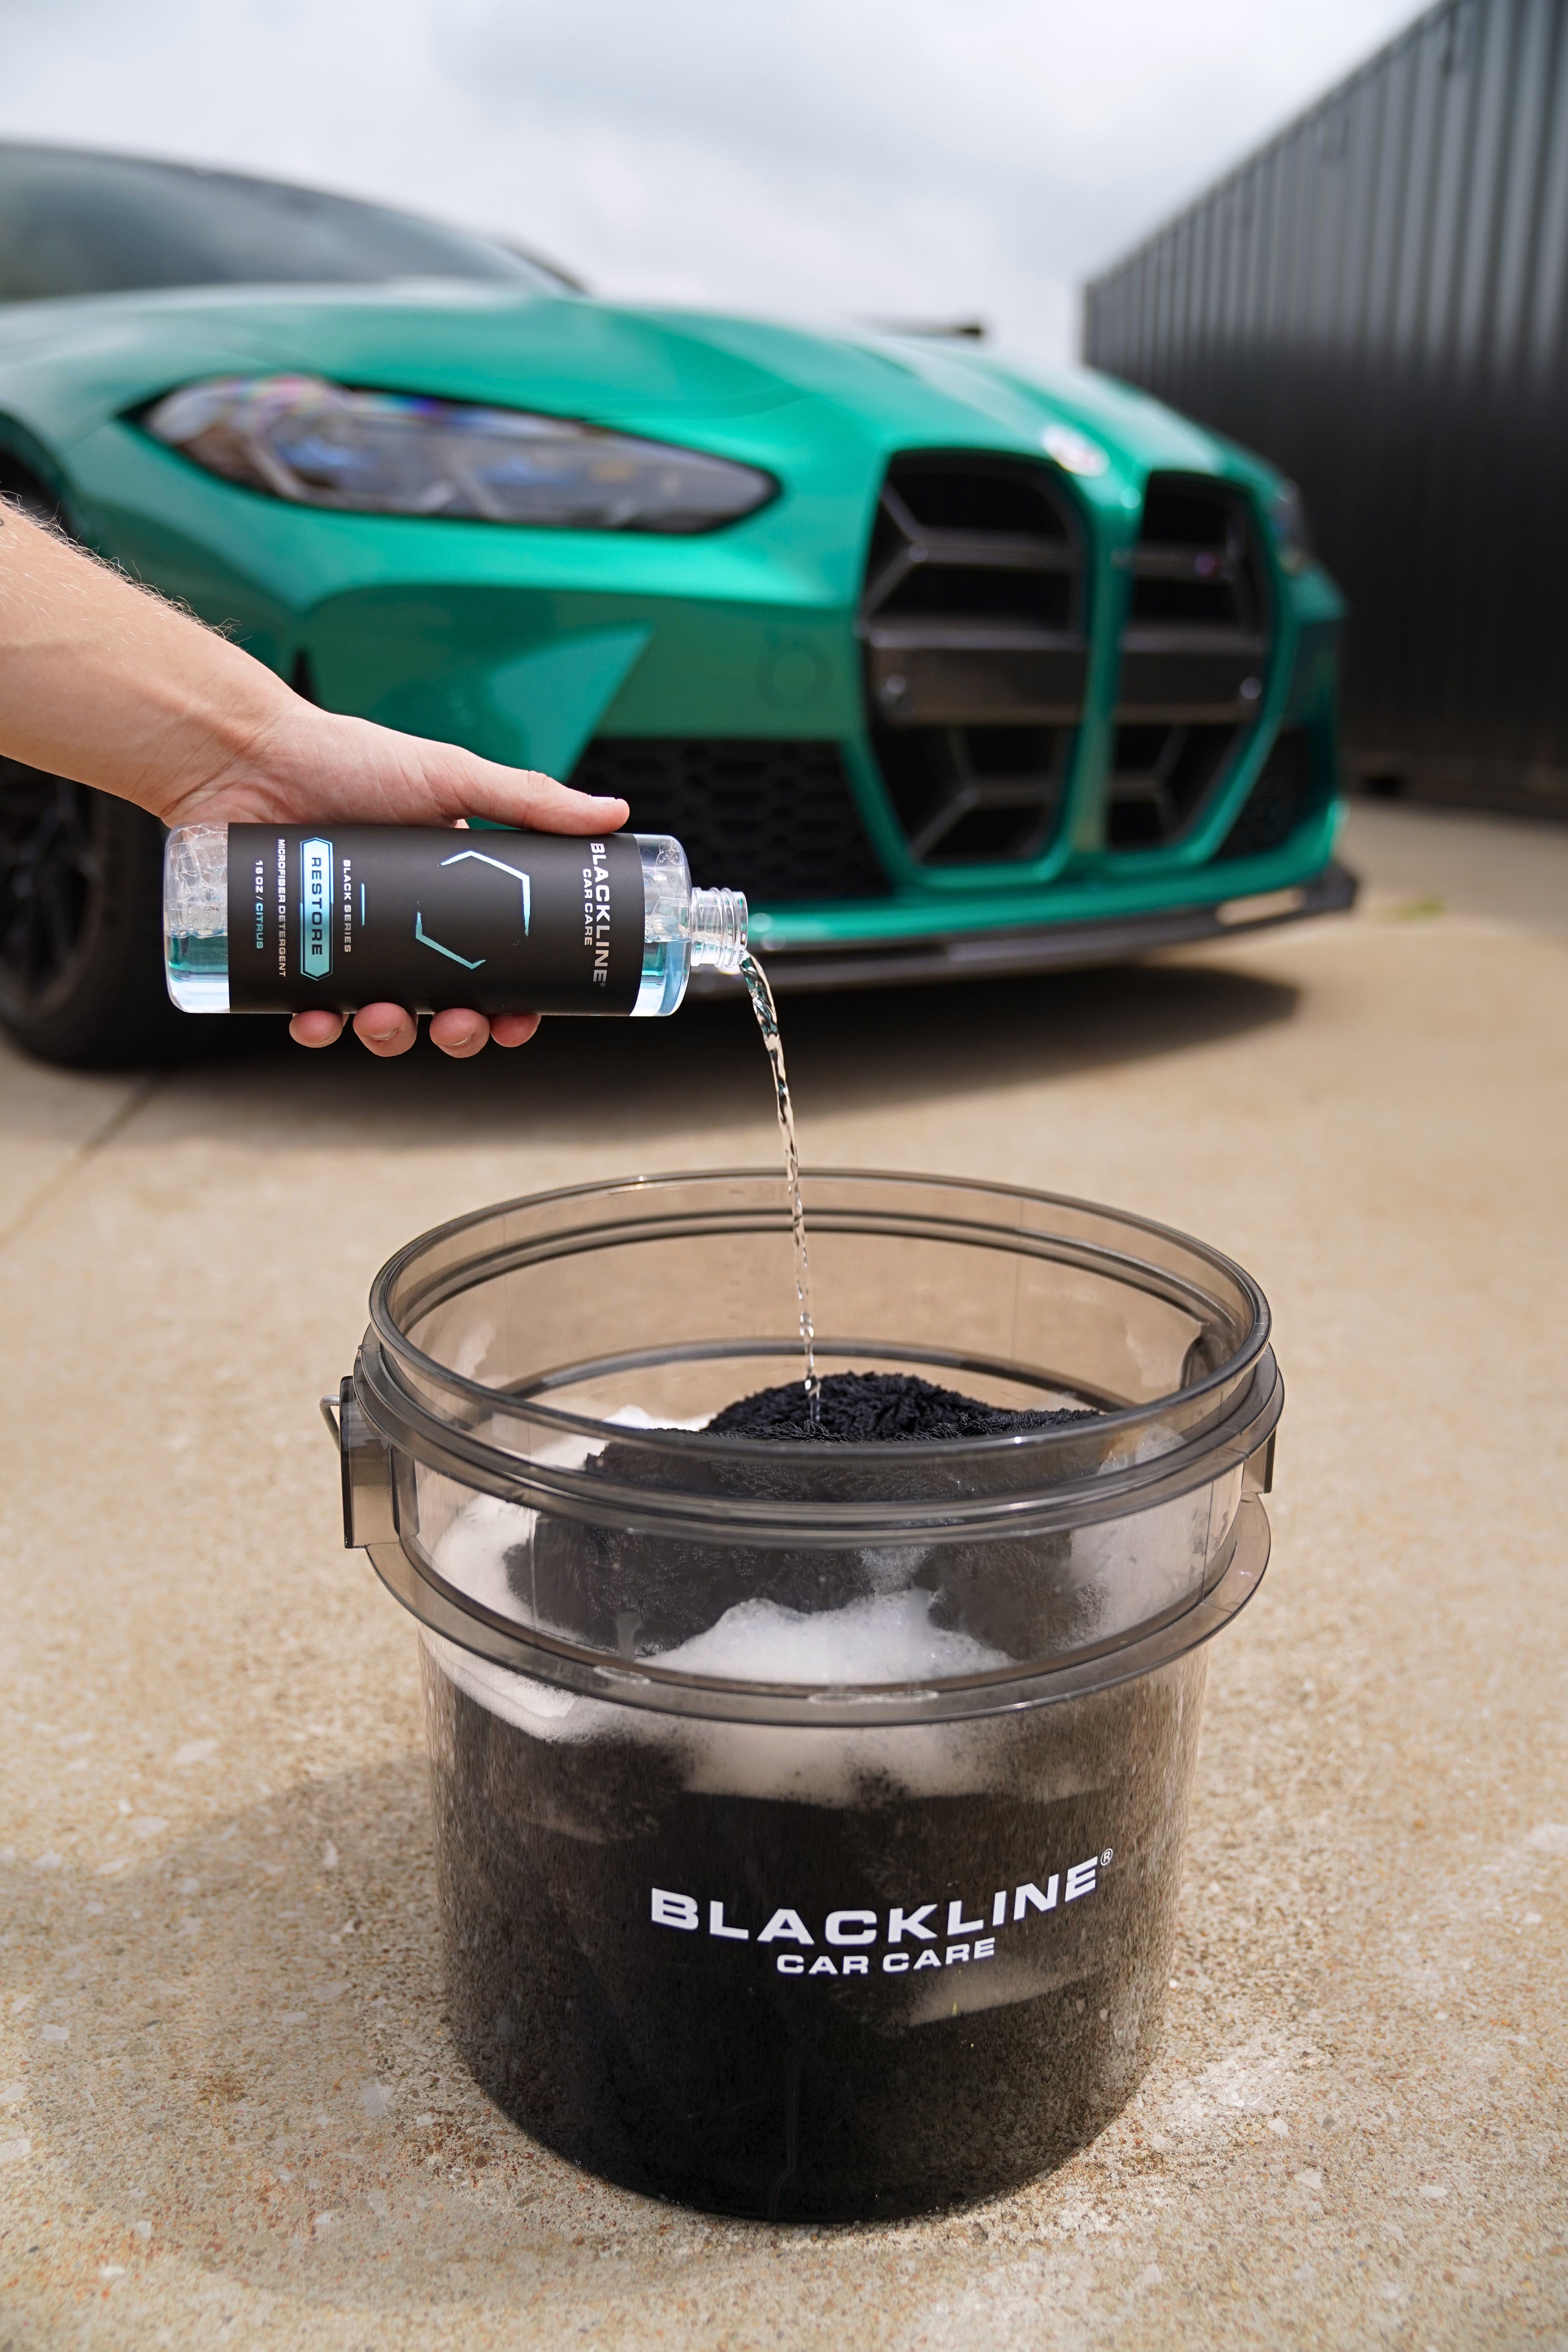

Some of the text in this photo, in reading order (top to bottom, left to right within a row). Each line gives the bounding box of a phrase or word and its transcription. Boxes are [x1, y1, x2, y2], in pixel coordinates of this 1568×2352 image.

[255, 860, 263, 874] 16
[255, 877, 263, 894] OZ
[255, 903, 264, 950] CITRUS
[278, 838, 286, 977] MICROFIBER DETERGENT
[312, 857, 322, 956] RESTORE
[343, 860, 352, 953] BLACK SERIES
[583, 868, 593, 946] CAR CARE
[776, 1937, 996, 1975] CAR CARE
